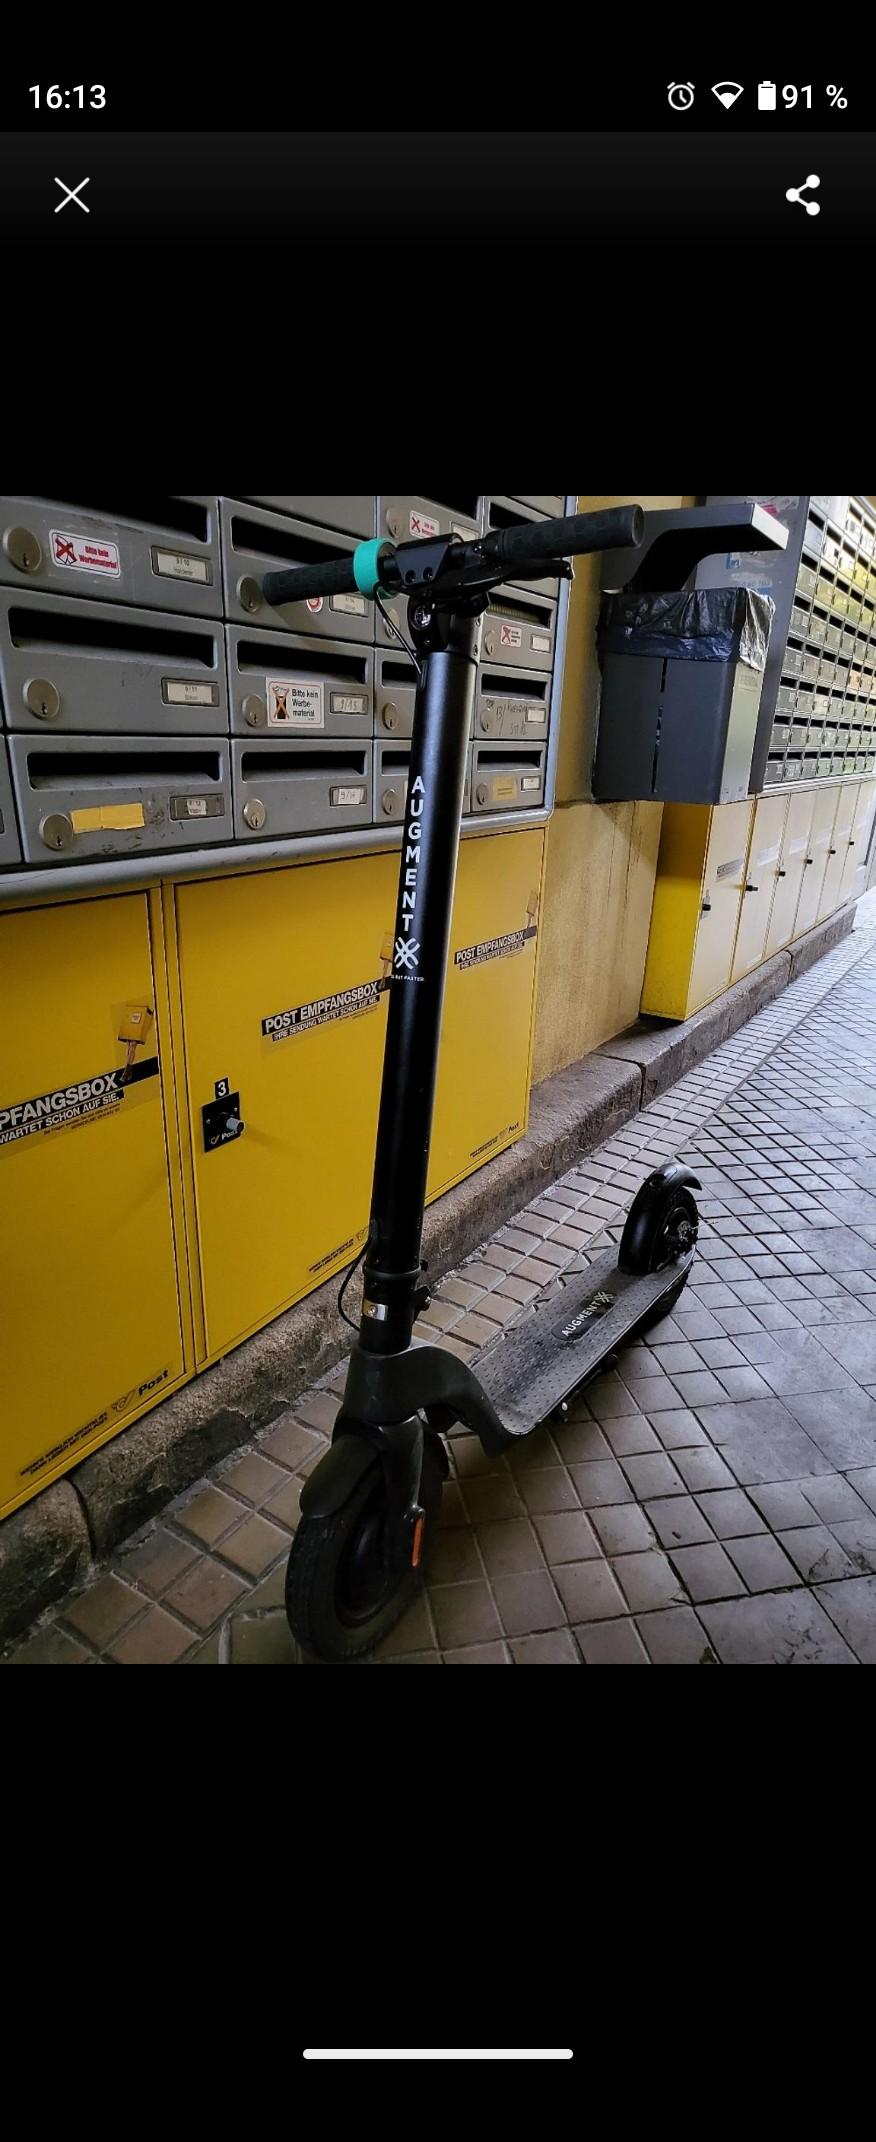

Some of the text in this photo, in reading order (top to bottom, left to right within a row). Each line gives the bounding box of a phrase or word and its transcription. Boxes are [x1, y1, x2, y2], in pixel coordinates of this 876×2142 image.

[291, 688, 319, 698] Bitte kein
[292, 699, 312, 708] Werbe-
[292, 709, 315, 717] material
[402, 775, 426, 932] AUGMENT
[456, 948, 475, 964] POST
[476, 930, 524, 956] EMPFANGSBOX
[264, 1010, 298, 1034] POST
[300, 981, 378, 1020] EMPFANGSBOX
[289, 1020, 317, 1035] SENDUNG
[0, 1072, 118, 1130] PFANGSBOX
[217, 1081, 227, 1097] 3
[0, 1120, 43, 1144] WARTET
[45, 1107, 80, 1127] SCHON
[82, 1099, 101, 1114] AUF
[102, 1093, 120, 1105] SIE.
[561, 1300, 601, 1337] AUGMENT
[138, 1369, 169, 1397] Post
